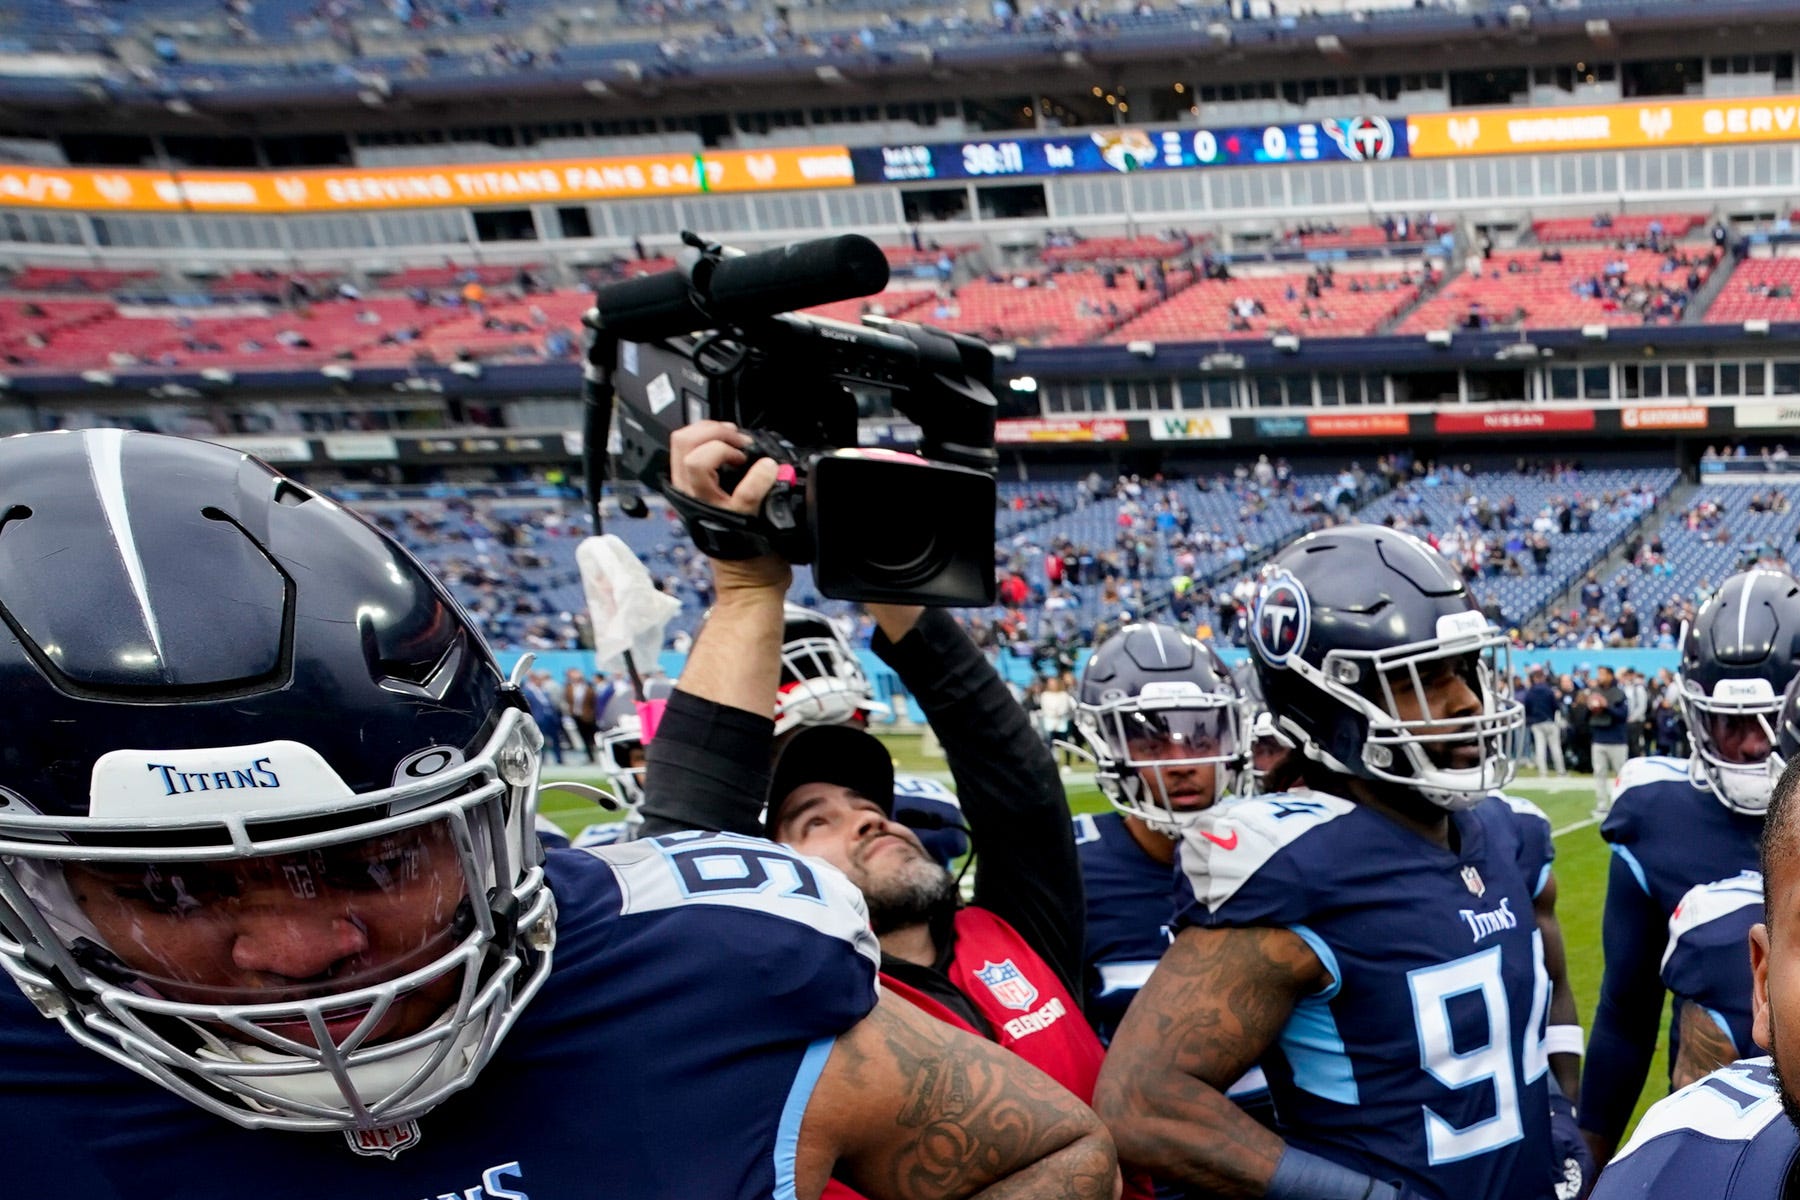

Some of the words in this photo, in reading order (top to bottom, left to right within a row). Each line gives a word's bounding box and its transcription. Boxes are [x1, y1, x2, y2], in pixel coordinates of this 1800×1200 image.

[1193, 130, 1217, 163] 0
[1263, 126, 1286, 159] 0
[325, 174, 451, 202] SERVING
[455, 168, 560, 196] TITANS
[566, 165, 644, 190] FANS
[1483, 414, 1544, 427] NISSAN
[147, 757, 281, 796] TITANS
[1459, 898, 1518, 943] TITANS
[360, 1121, 410, 1148] NFL
